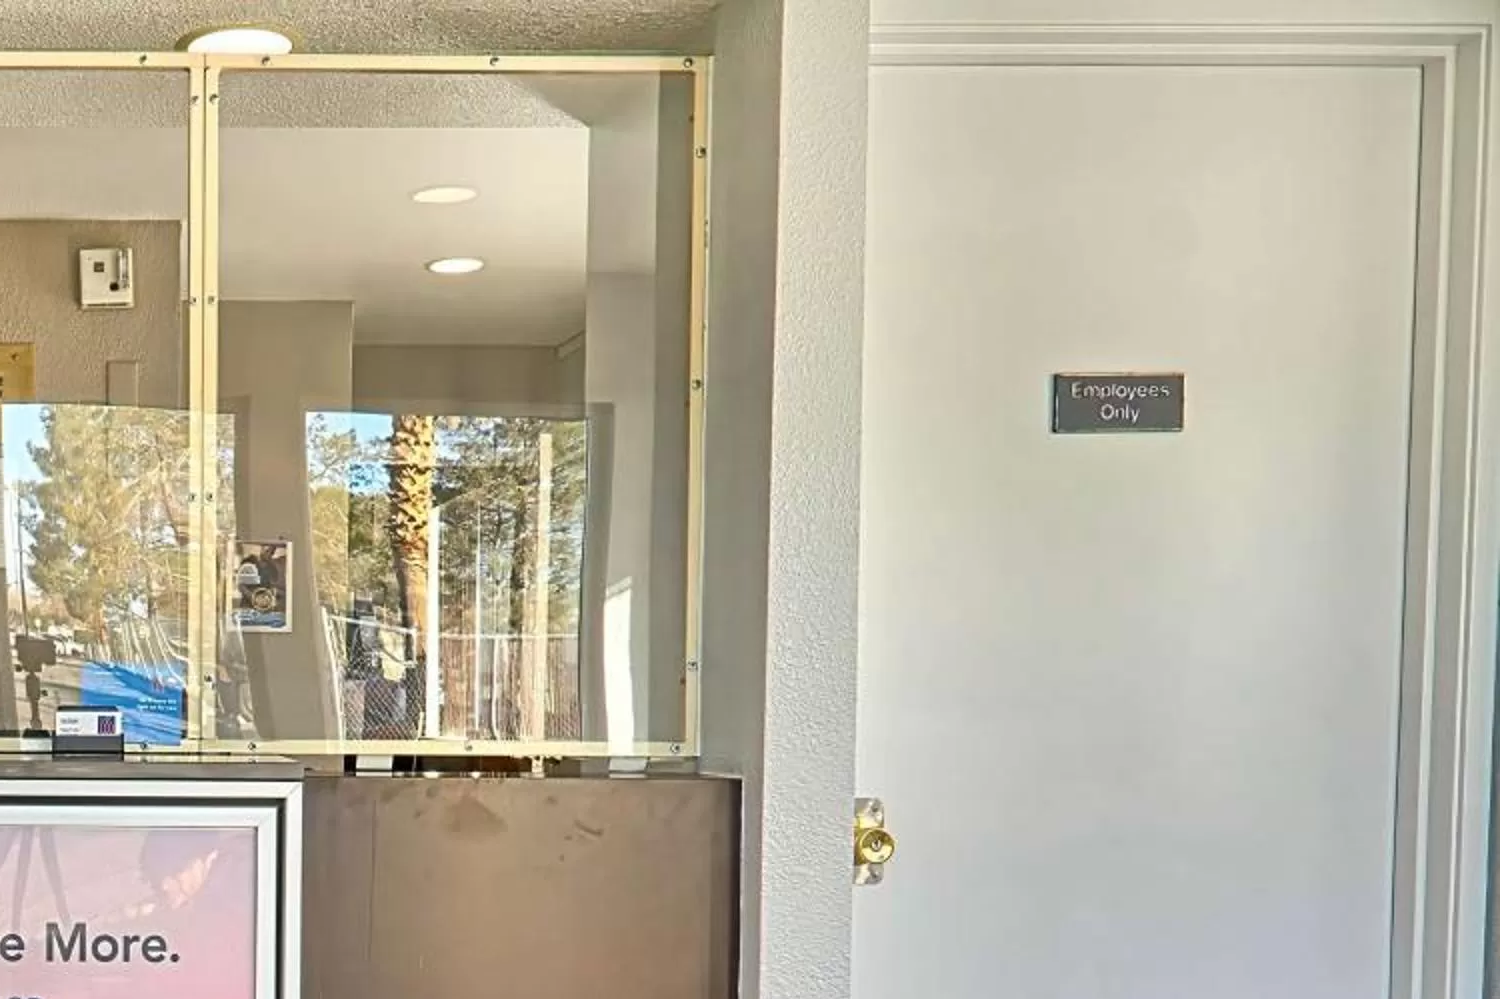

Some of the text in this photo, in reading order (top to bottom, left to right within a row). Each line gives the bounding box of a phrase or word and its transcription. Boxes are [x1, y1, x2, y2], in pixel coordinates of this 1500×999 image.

[1071, 382, 1171, 400] Employees
[1100, 403, 1140, 424] Only
[45, 922, 181, 963] More.
